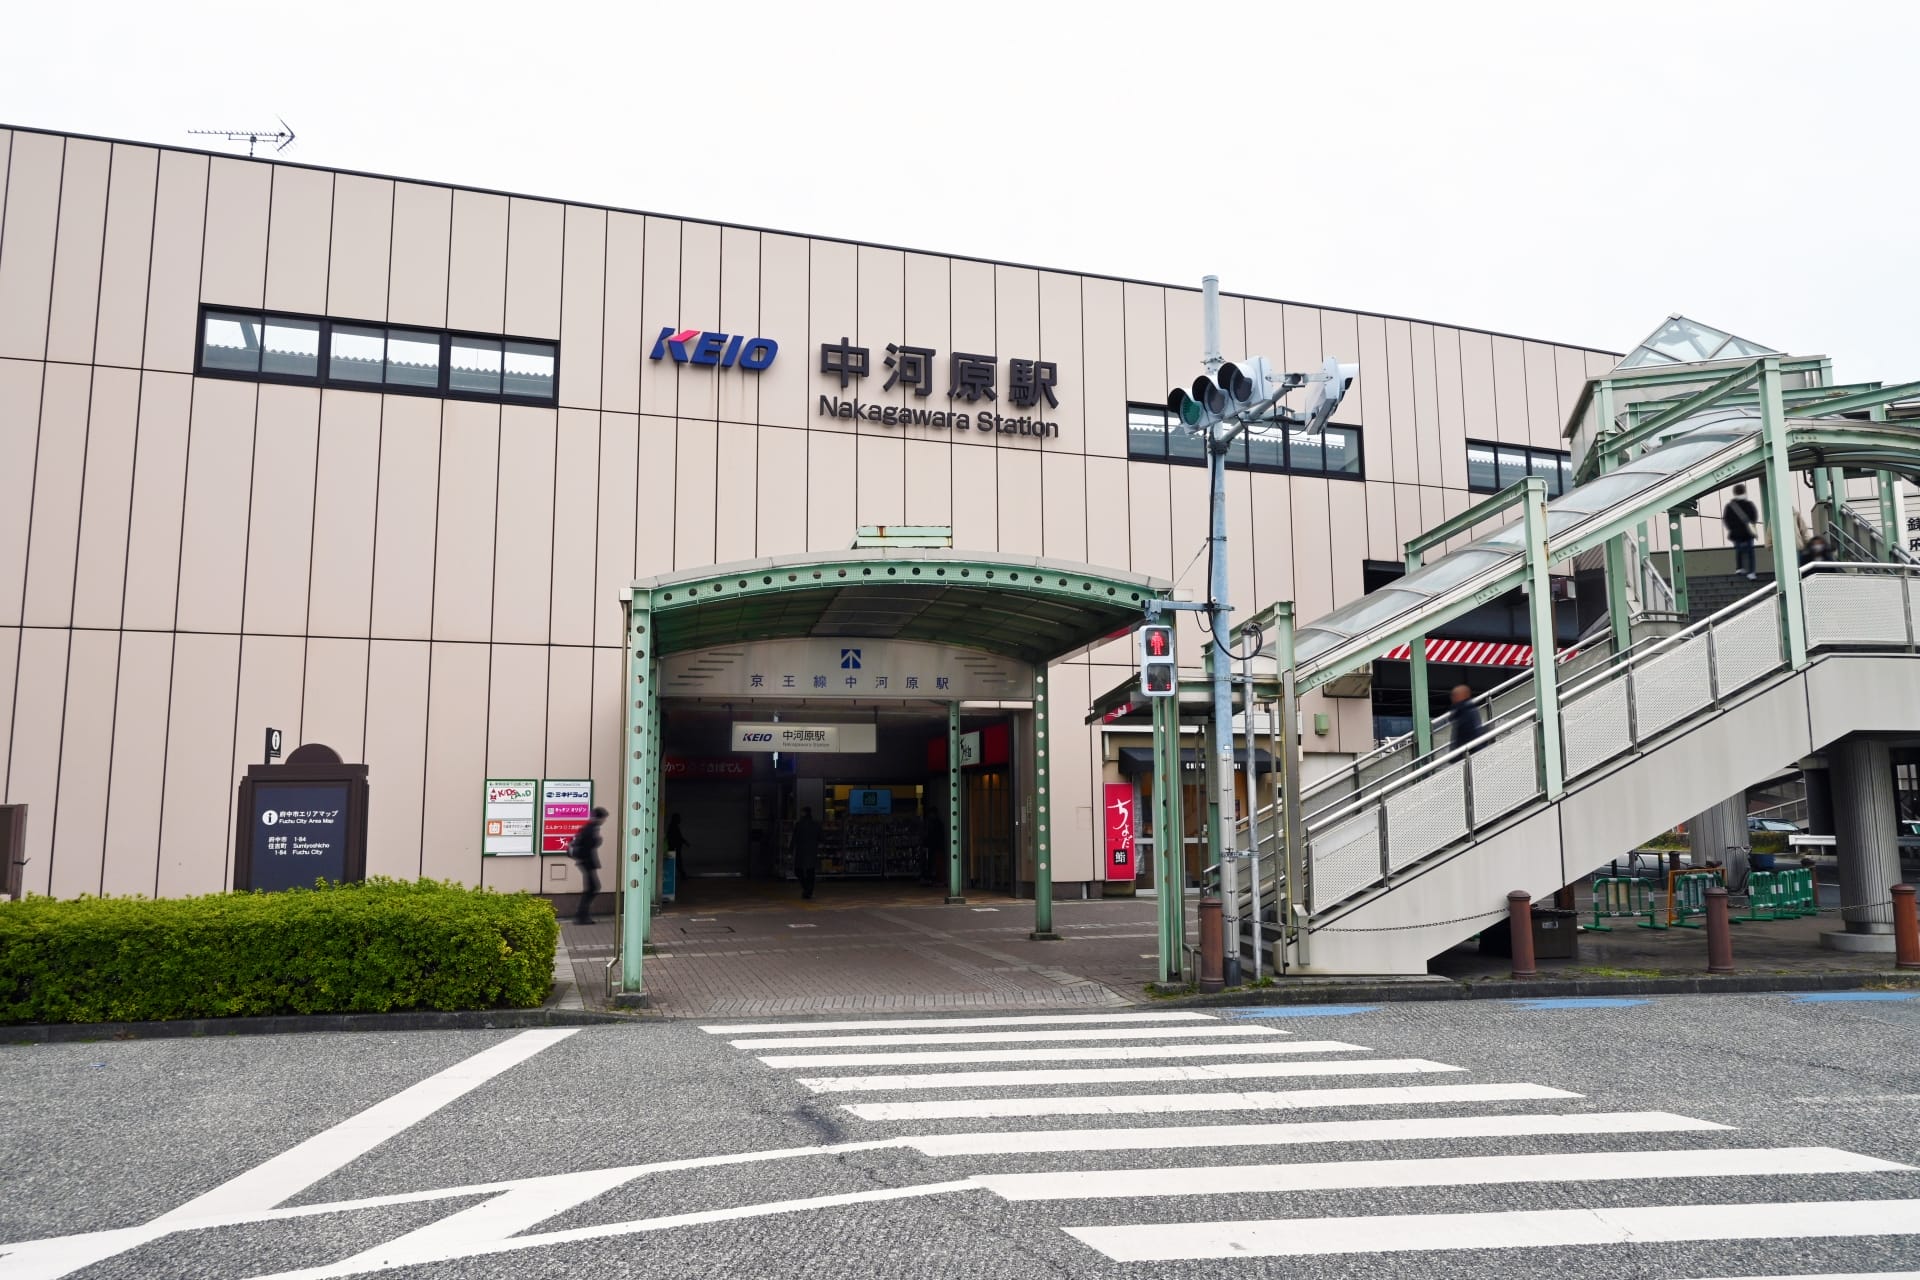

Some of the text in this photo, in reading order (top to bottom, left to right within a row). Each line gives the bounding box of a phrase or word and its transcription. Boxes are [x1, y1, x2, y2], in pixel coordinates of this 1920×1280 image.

[649, 327, 778, 373] KEIO
[820, 336, 1059, 409] 中河原駅
[819, 395, 1059, 439] Nakagawara Station
[750, 675, 950, 690] 京王線中河原駅
[742, 732, 773, 742] KEIO
[783, 730, 825, 741] 中河原駅
[279, 810, 339, 818] 府中市エリアマップ
